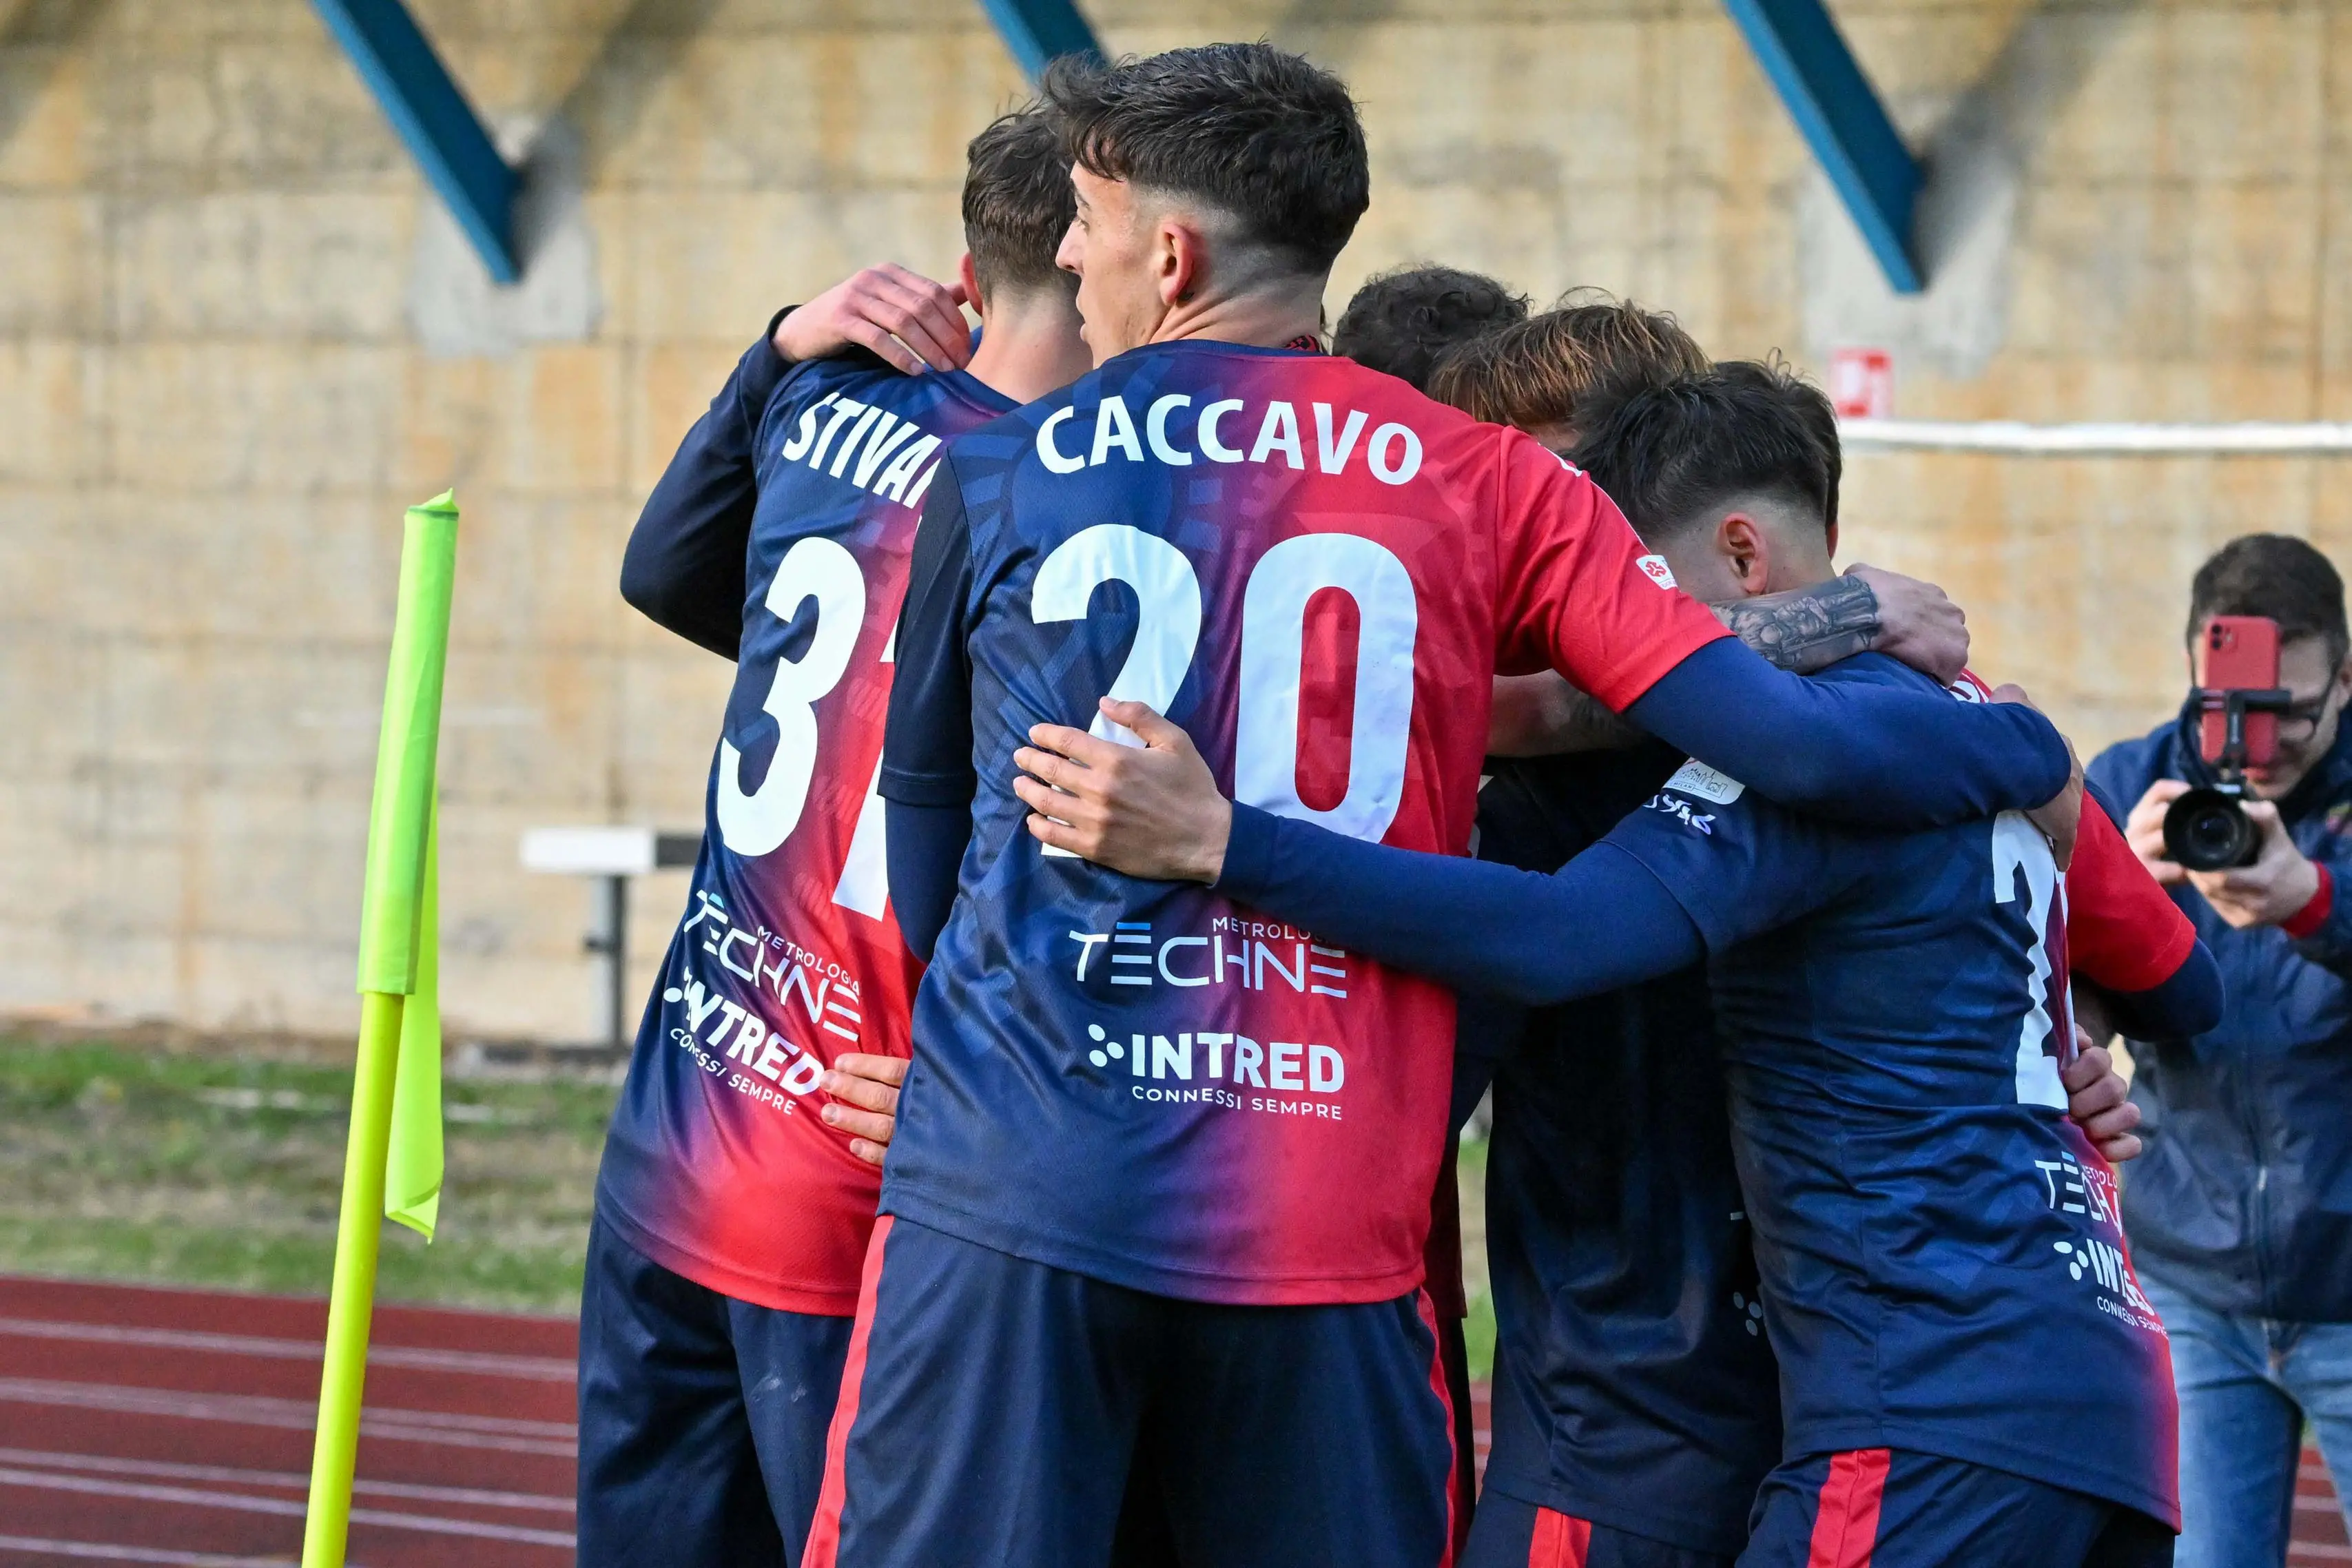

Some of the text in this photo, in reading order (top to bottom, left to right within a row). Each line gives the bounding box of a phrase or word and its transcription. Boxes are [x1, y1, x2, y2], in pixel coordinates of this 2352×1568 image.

[1035, 393, 1423, 485] CACCAVO
[1031, 524, 1417, 858] 20
[1069, 922, 1347, 998] TECHNE
[728, 1073, 796, 1115] SEMPRE
[1132, 1033, 1344, 1093] INTRED
[1132, 1086, 1342, 1120] CONNESSI SEMPRE
